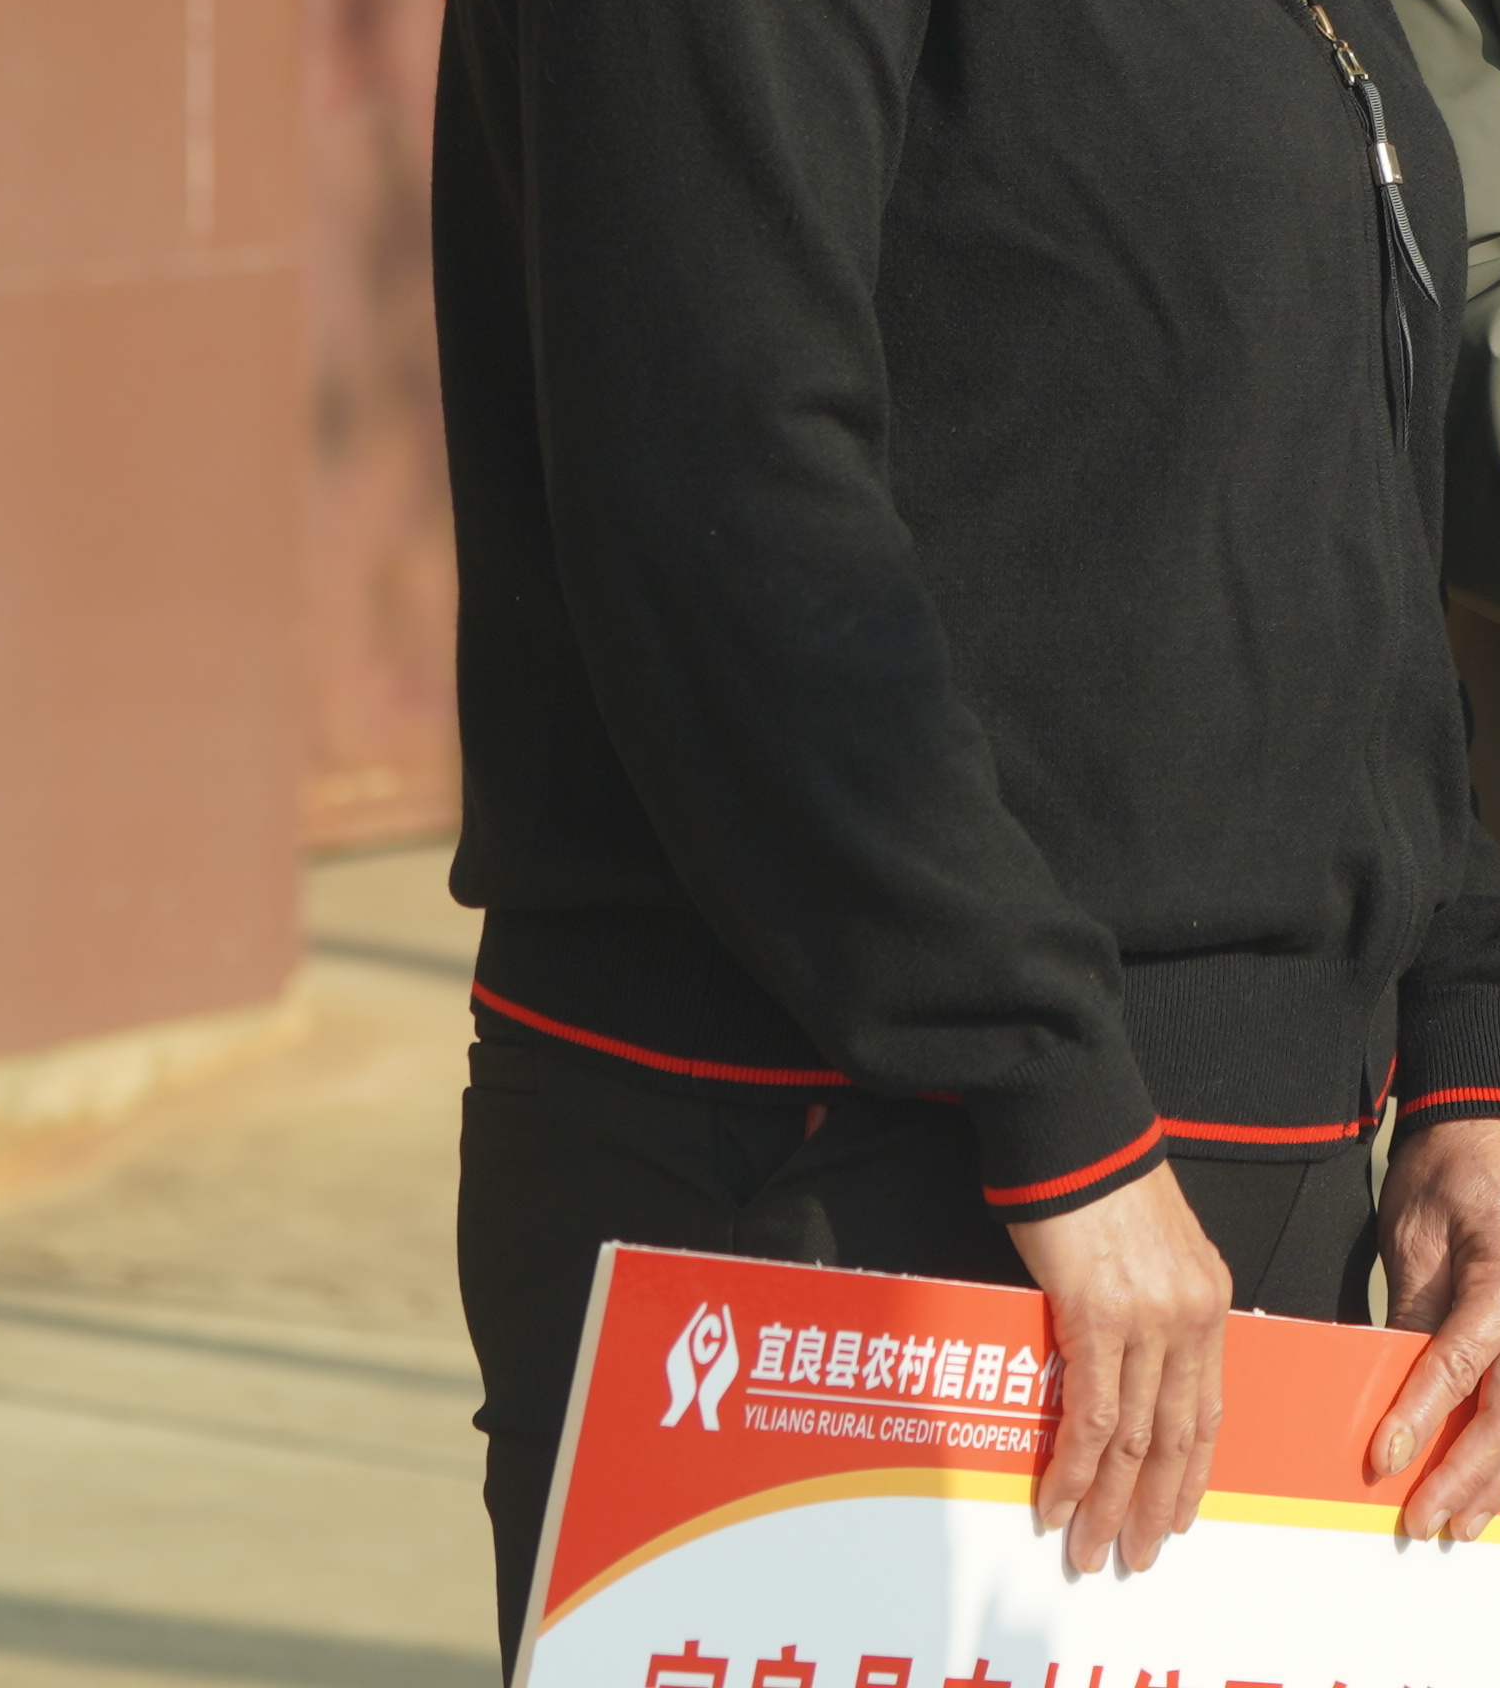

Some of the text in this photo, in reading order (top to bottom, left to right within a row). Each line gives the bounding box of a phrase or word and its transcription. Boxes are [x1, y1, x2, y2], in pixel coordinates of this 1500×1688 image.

[745, 1404, 815, 1434] YILIANG
[816, 1410, 876, 1440] RURAL
[880, 1416, 947, 1446] CREDIT
